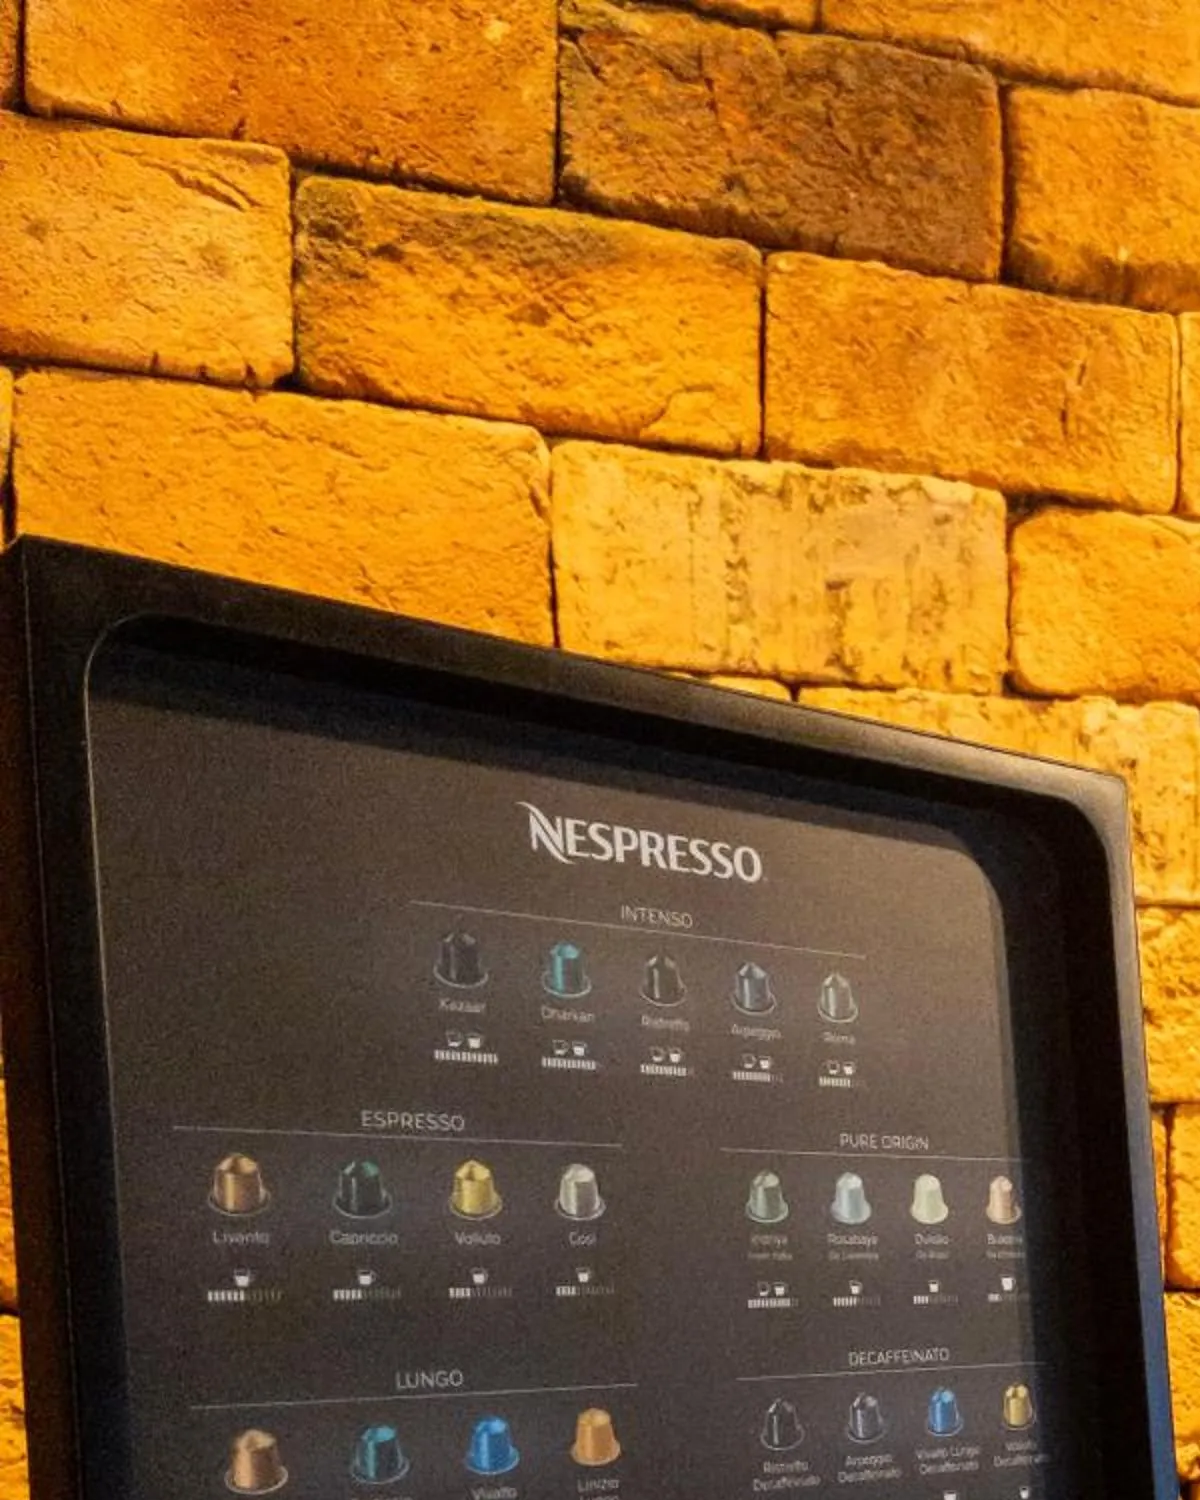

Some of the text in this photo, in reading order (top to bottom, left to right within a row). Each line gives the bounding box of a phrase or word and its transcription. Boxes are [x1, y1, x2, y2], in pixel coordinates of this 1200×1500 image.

[516, 801, 763, 884] NESPRESSO
[621, 905, 693, 929] INTENSO
[361, 1110, 465, 1132] ESPRESSO
[839, 1133, 930, 1150] PURE ORIGIN
[849, 1347, 950, 1367] DECAFFEINATO
[394, 1369, 464, 1390] LUNGO
